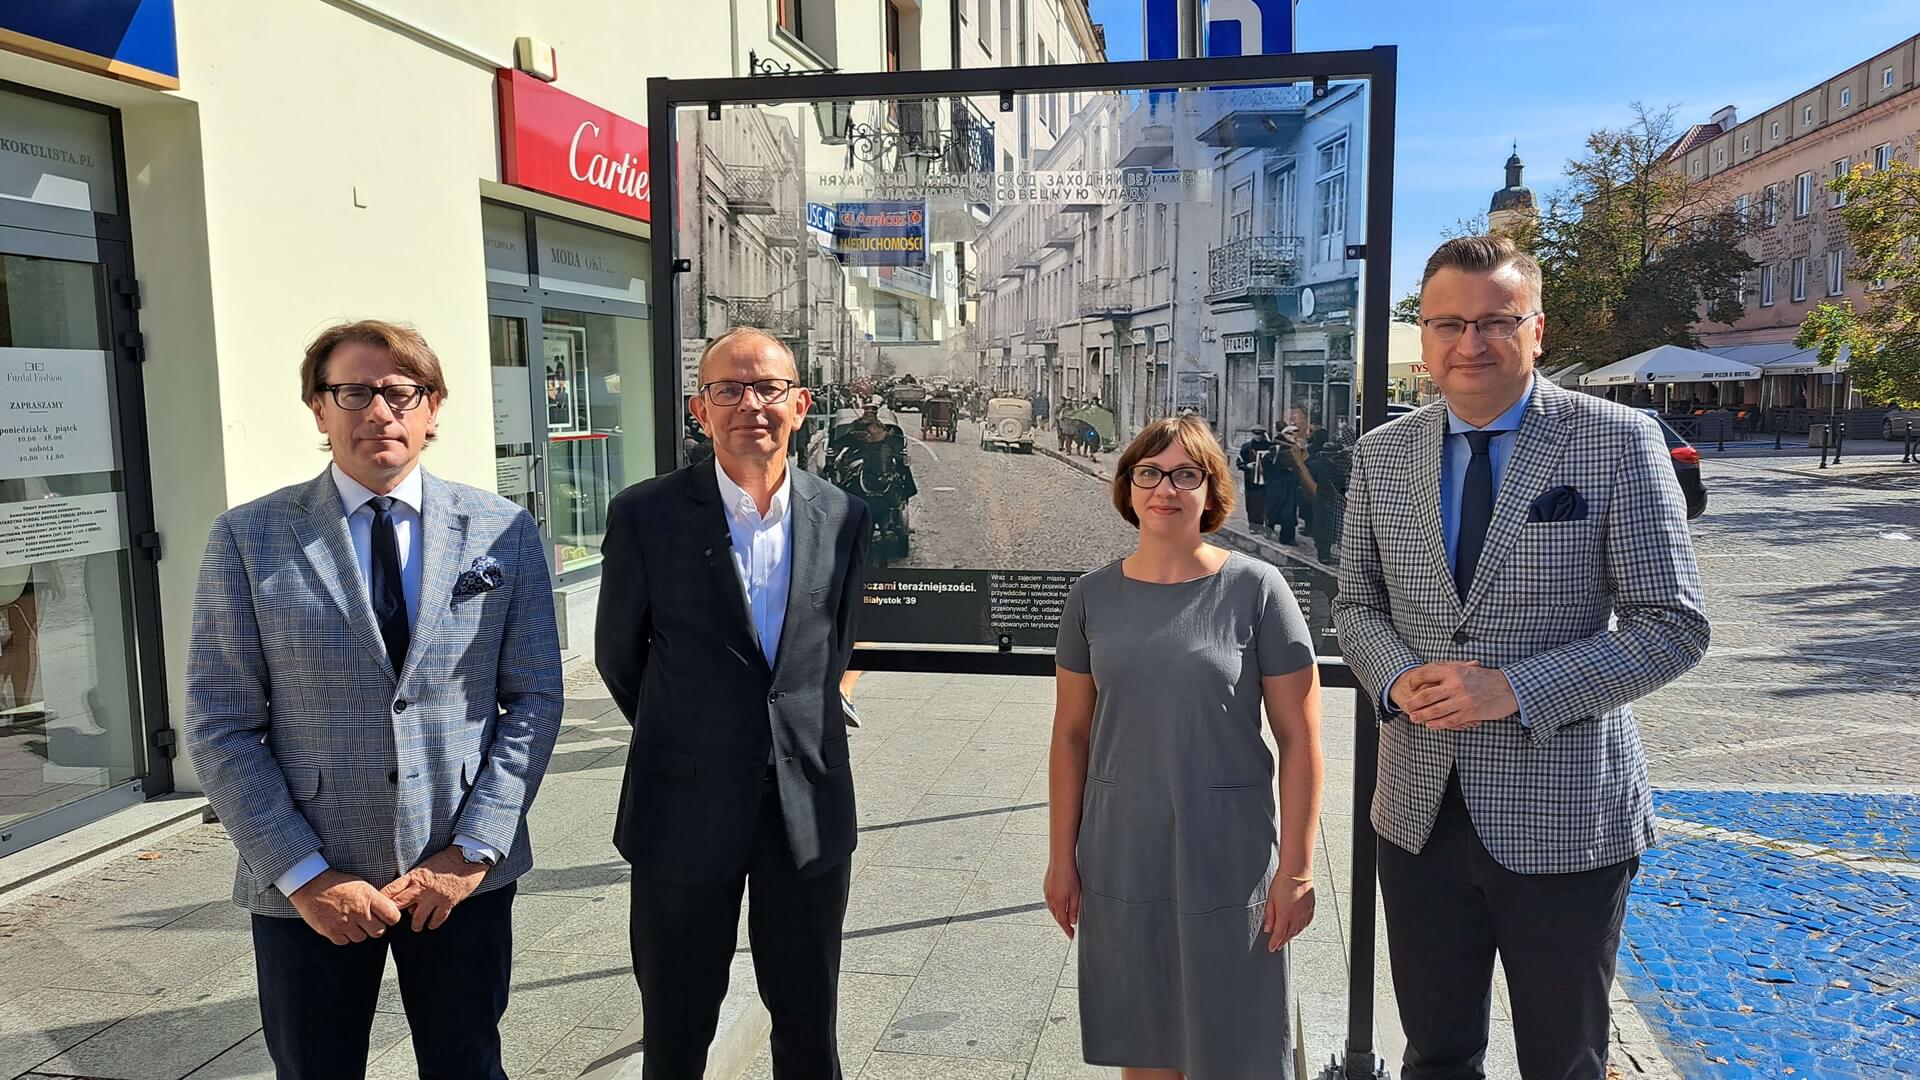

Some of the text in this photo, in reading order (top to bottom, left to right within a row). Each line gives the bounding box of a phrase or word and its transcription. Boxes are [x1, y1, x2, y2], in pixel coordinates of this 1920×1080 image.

[0, 137, 94, 167] KOKULISTA.PL
[569, 120, 650, 202] Cartie
[997, 173, 1037, 187] СХОД
[997, 187, 1089, 201] СОВЕЦКУЮ
[824, 209, 835, 231] 4D
[856, 212, 907, 227] Amicus
[840, 234, 923, 250] NIERUCHOMOŚCI
[551, 247, 581, 267] MODA
[1409, 364, 1429, 373] TYS
[9, 401, 64, 410] ZAPRASZAMY
[55, 424, 78, 434] piątek
[898, 581, 977, 593] teraźniejszości.
[863, 596, 902, 606] Białystok
[999, 598, 1031, 606] pierwszych
[990, 621, 1030, 629] okupowanych
